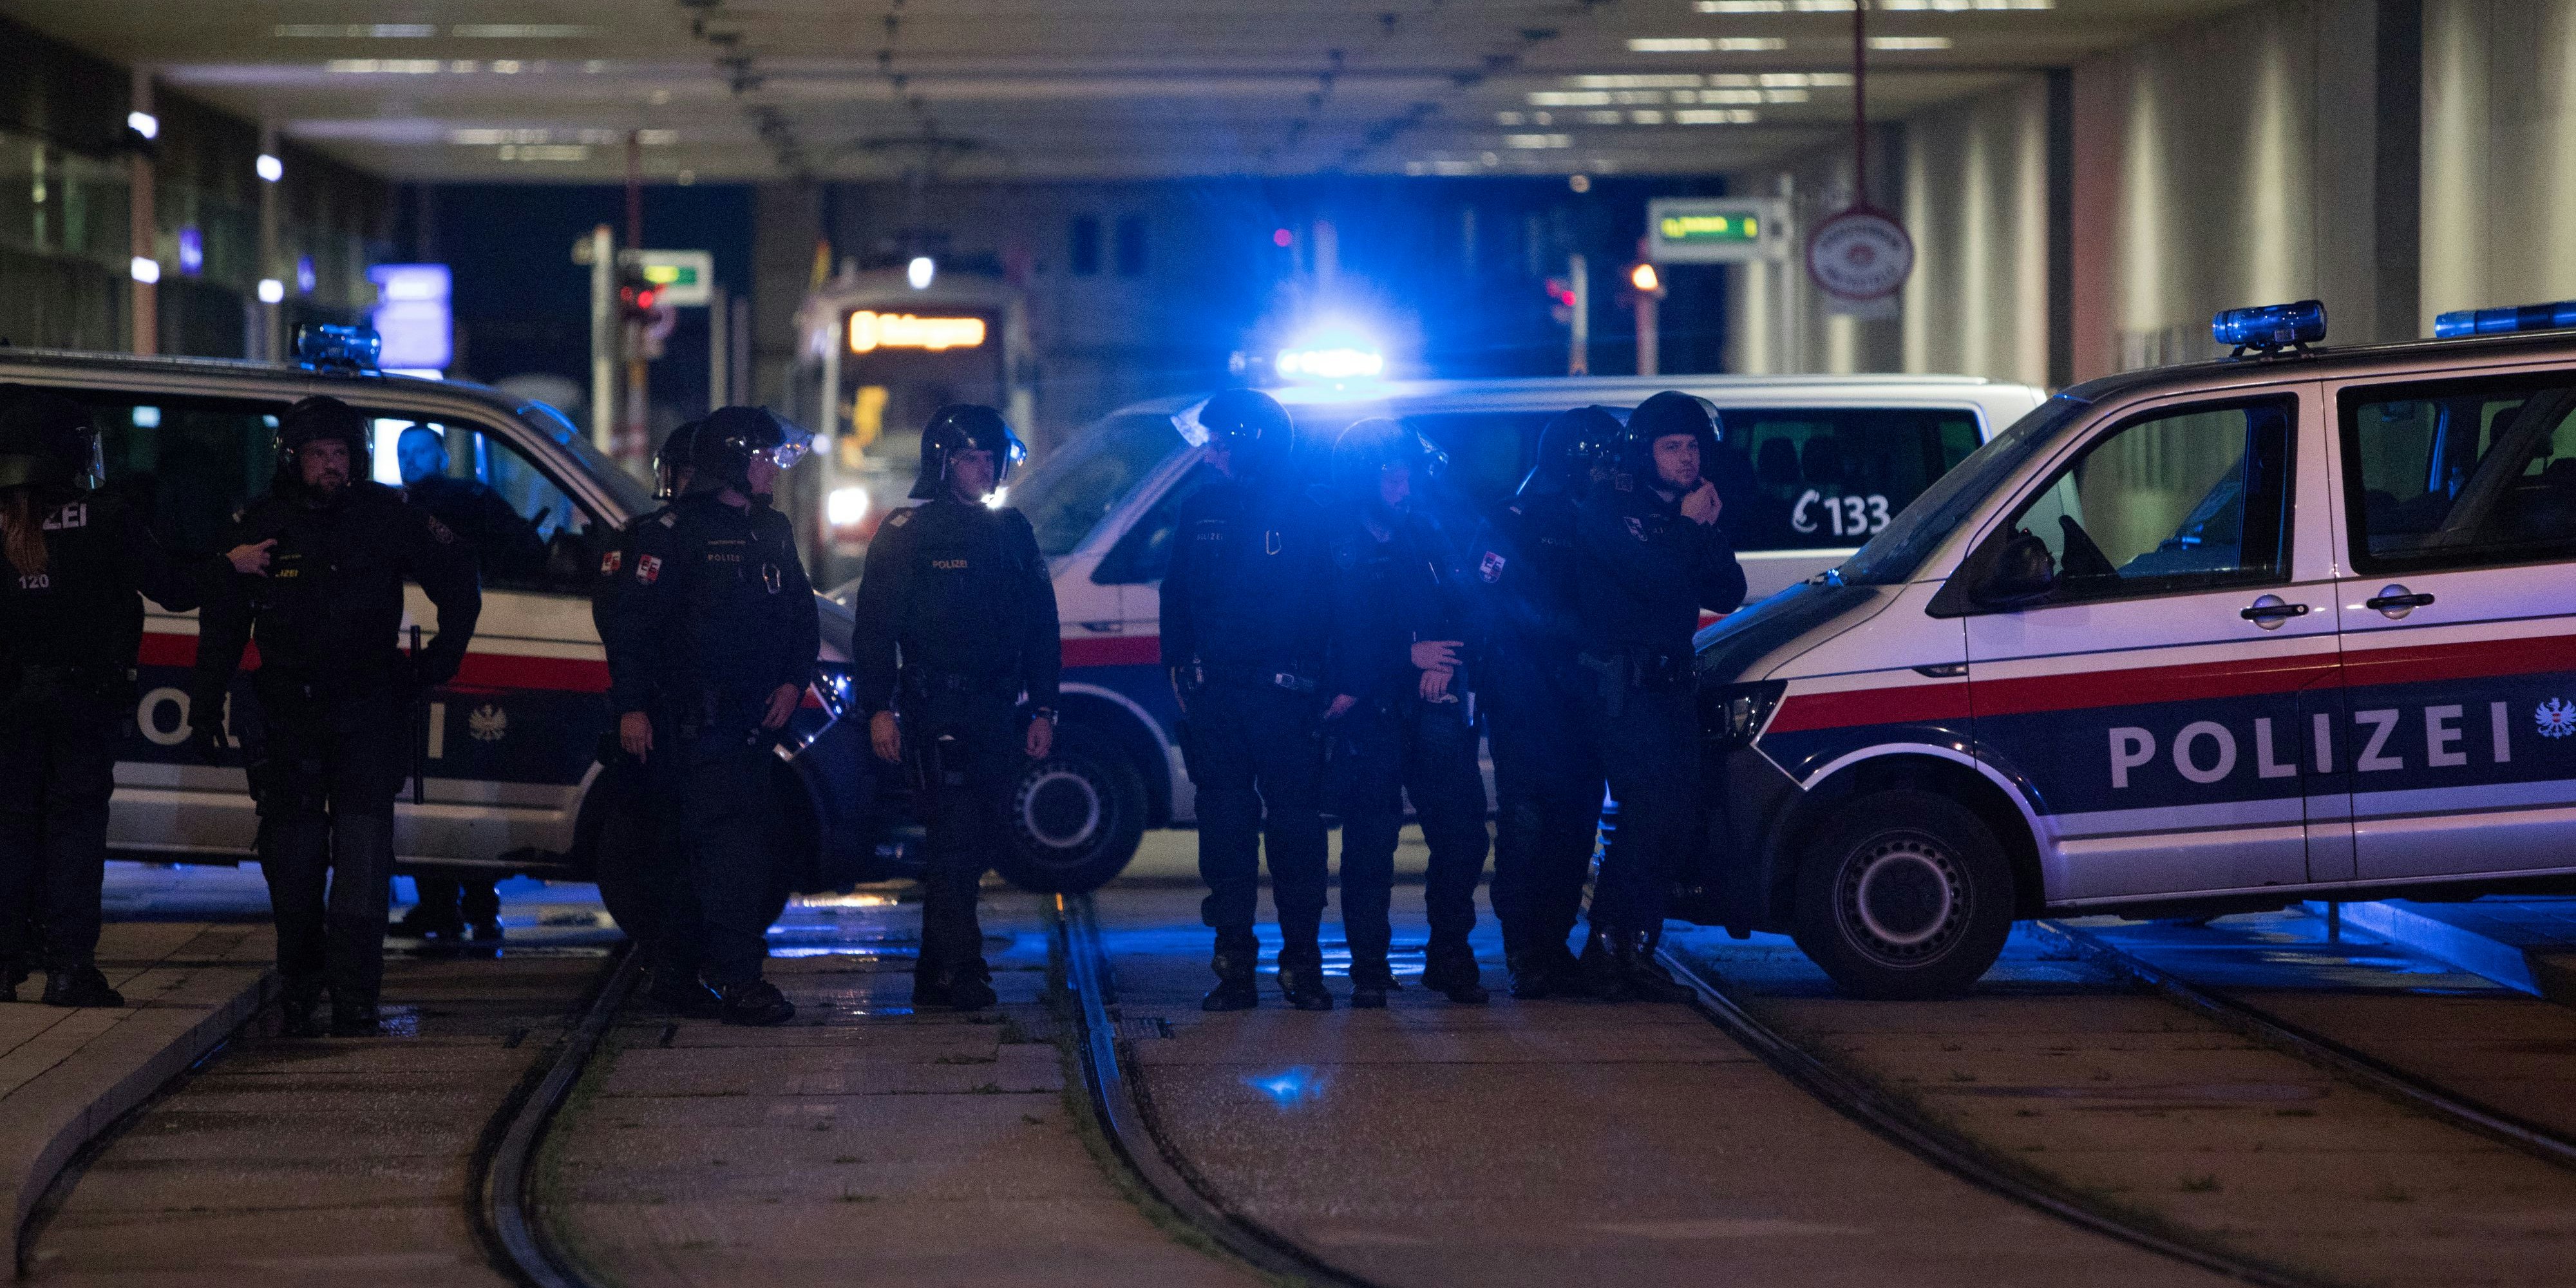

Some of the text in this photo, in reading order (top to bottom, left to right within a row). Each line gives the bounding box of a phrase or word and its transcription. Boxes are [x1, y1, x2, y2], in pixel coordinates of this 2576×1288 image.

[1824, 495, 1891, 535] 133
[933, 559, 967, 569] POLIZEI
[19, 573, 50, 589] 120
[2109, 701, 2512, 788] POLIZEI
